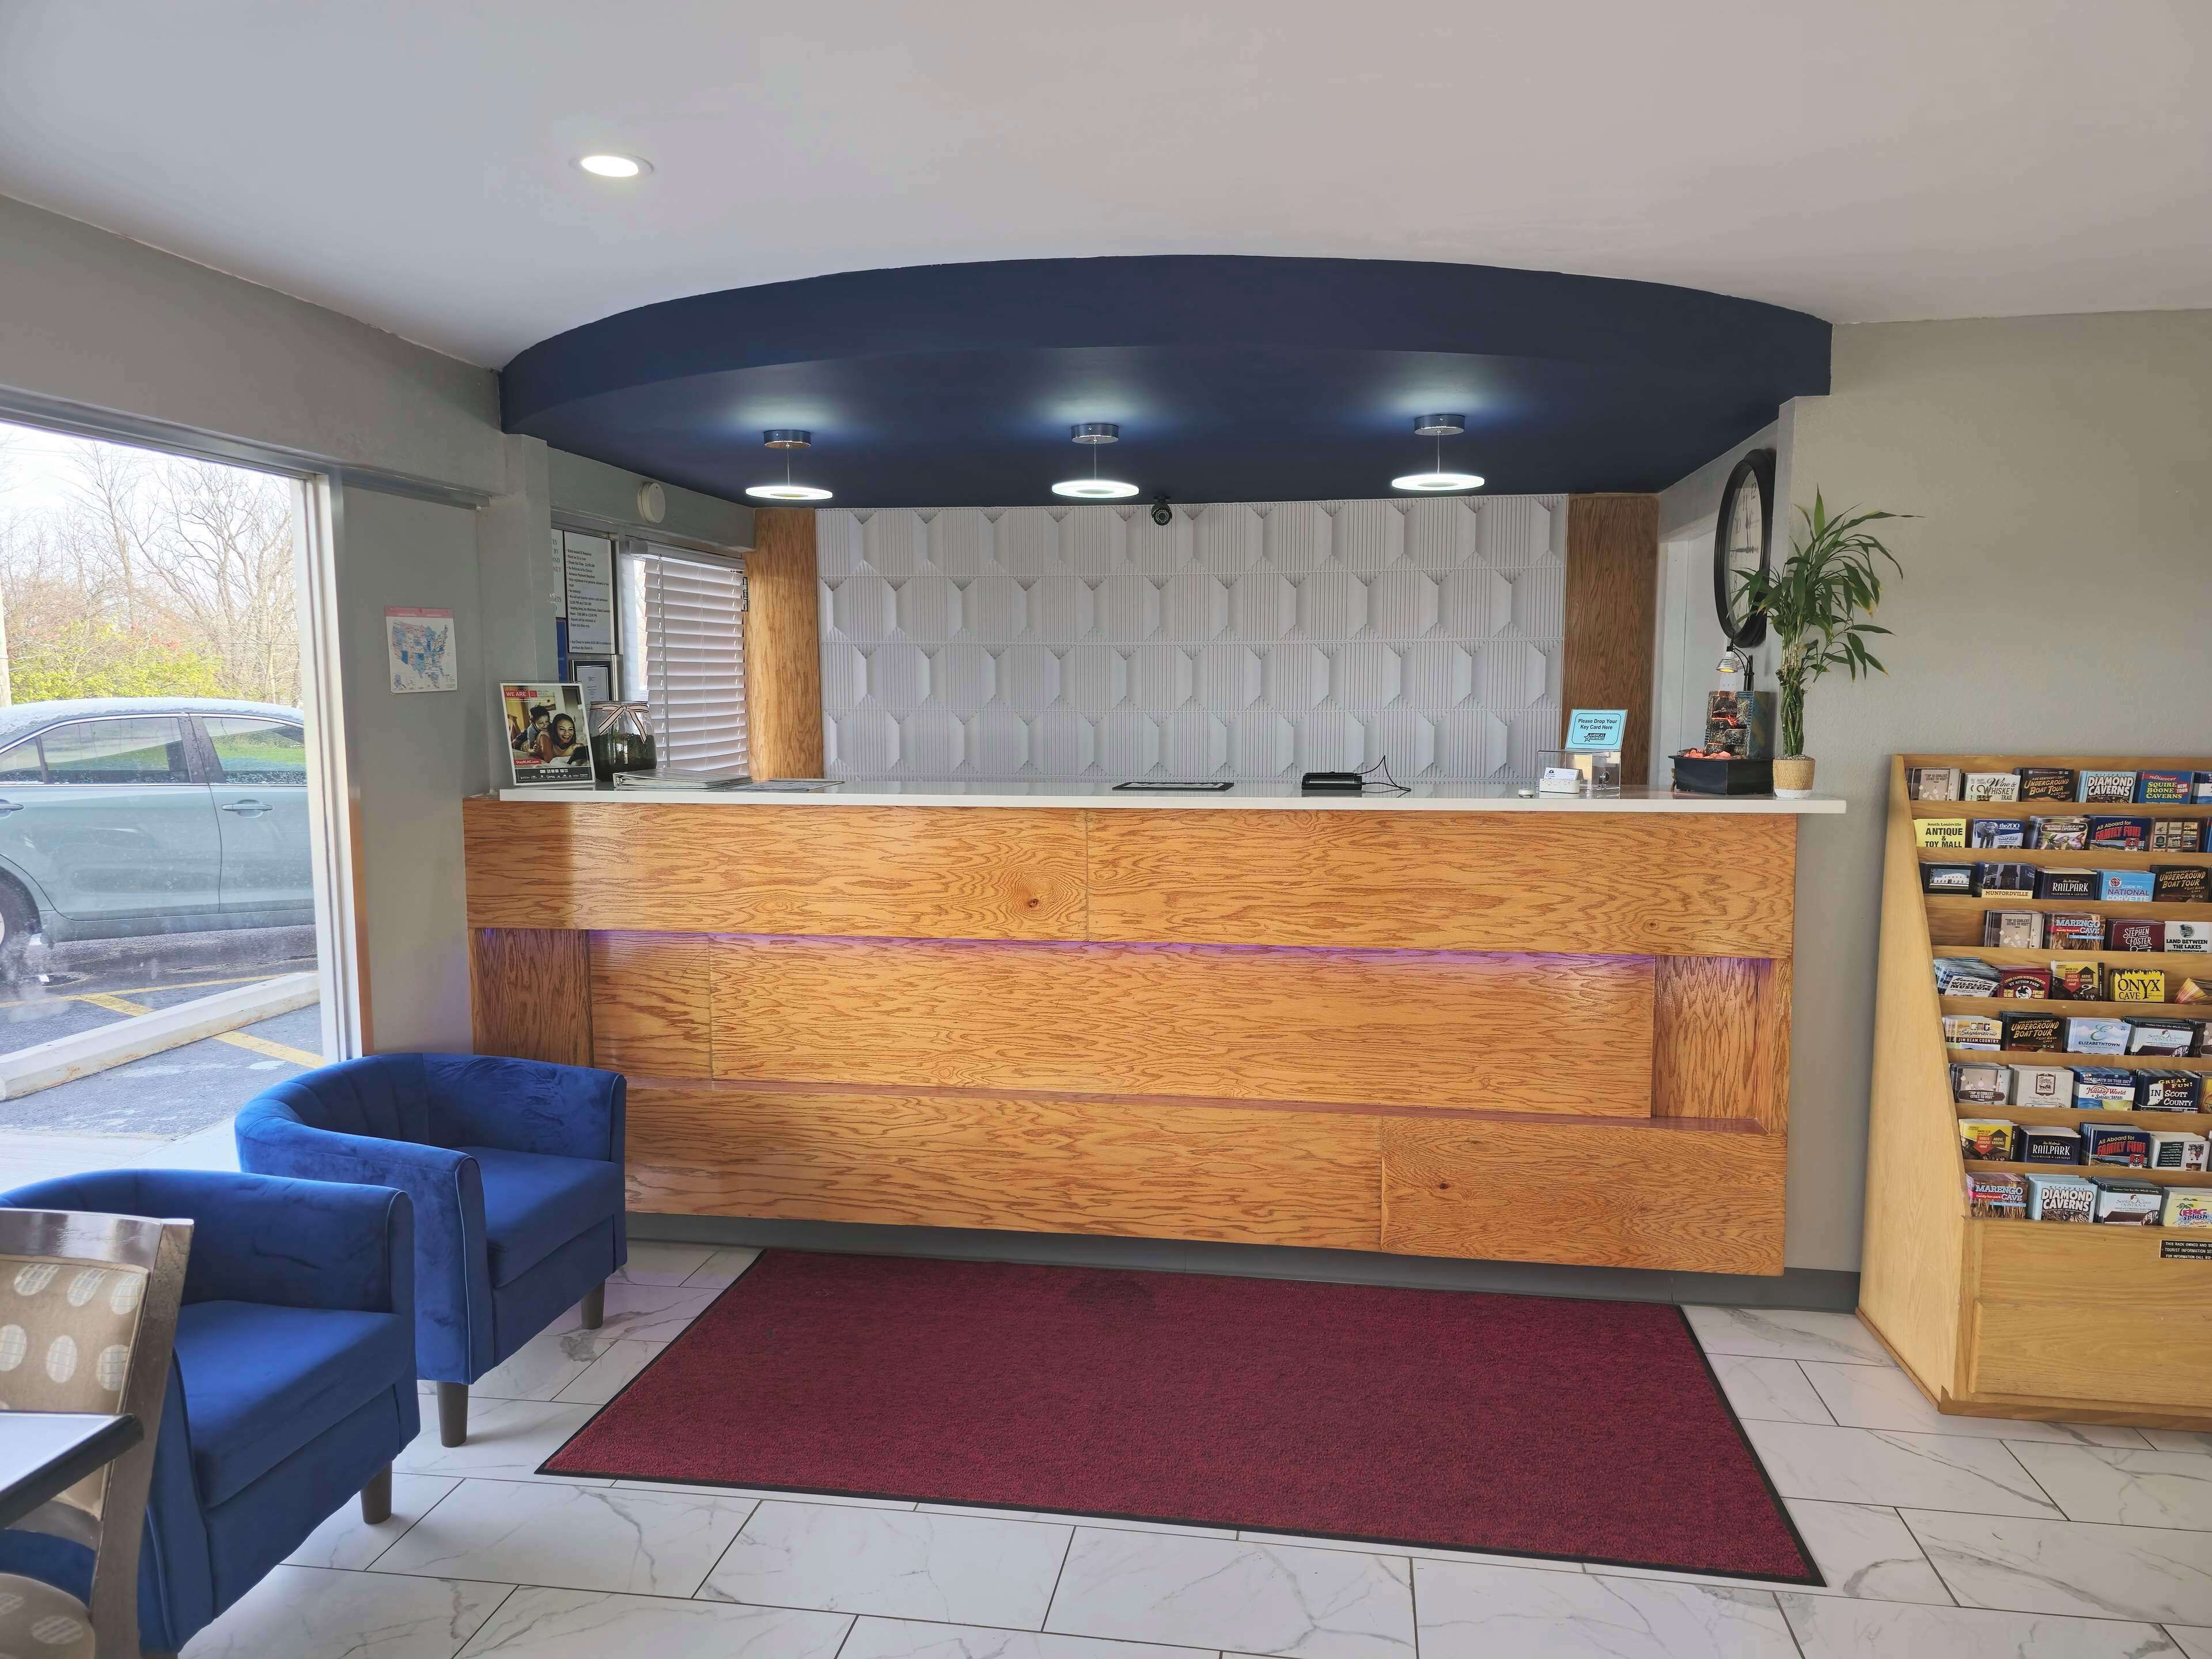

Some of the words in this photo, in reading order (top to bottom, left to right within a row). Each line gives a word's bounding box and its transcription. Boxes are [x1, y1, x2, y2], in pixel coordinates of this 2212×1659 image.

[1751, 482, 1756, 499] 12
[1743, 494, 1748, 512] 11
[1735, 517, 1741, 535] 10
[1734, 574, 1738, 591] 8
[1987, 778, 2009, 787] Wine
[2024, 779, 2069, 789] UNDERGROUND
[2088, 777, 2134, 787] DIAMOND
[1977, 785, 2014, 797] WHISKEY
[2029, 786, 2047, 795] BOAT
[2048, 786, 2064, 794] TOUR
[2088, 785, 2130, 796] CAVERNS
[2096, 827, 2122, 841] FAMILY
[2123, 827, 2141, 837] FUN!
[2160, 872, 2206, 881] UNDERGROUND
[2052, 882, 2088, 892] RAILPARK
[2162, 880, 2180, 888] BOAT
[2181, 879, 2200, 887] TOUR
[2055, 919, 2100, 928] MARENGO
[2123, 928, 2149, 938] STEPHEN
[2126, 936, 2152, 946] FOSTER
[2118, 979, 2161, 999] ONYX
[2119, 992, 2141, 1000] CAVE
[2011, 1021, 2059, 1031] UNDERGROUND
[2013, 1030, 2033, 1038] BOAT
[2033, 1029, 2052, 1037] TOUR
[2164, 1098, 2193, 1106] COUNTY
[2032, 1145, 2070, 1156] RAILPARK
[2097, 1142, 2126, 1156] FAMILY
[2127, 1141, 2146, 1152] FUN!
[1976, 1185, 2023, 1195] MARENGO
[2041, 1188, 2094, 1202] DIAMOND
[2043, 1199, 2090, 1212] CAVERNS
